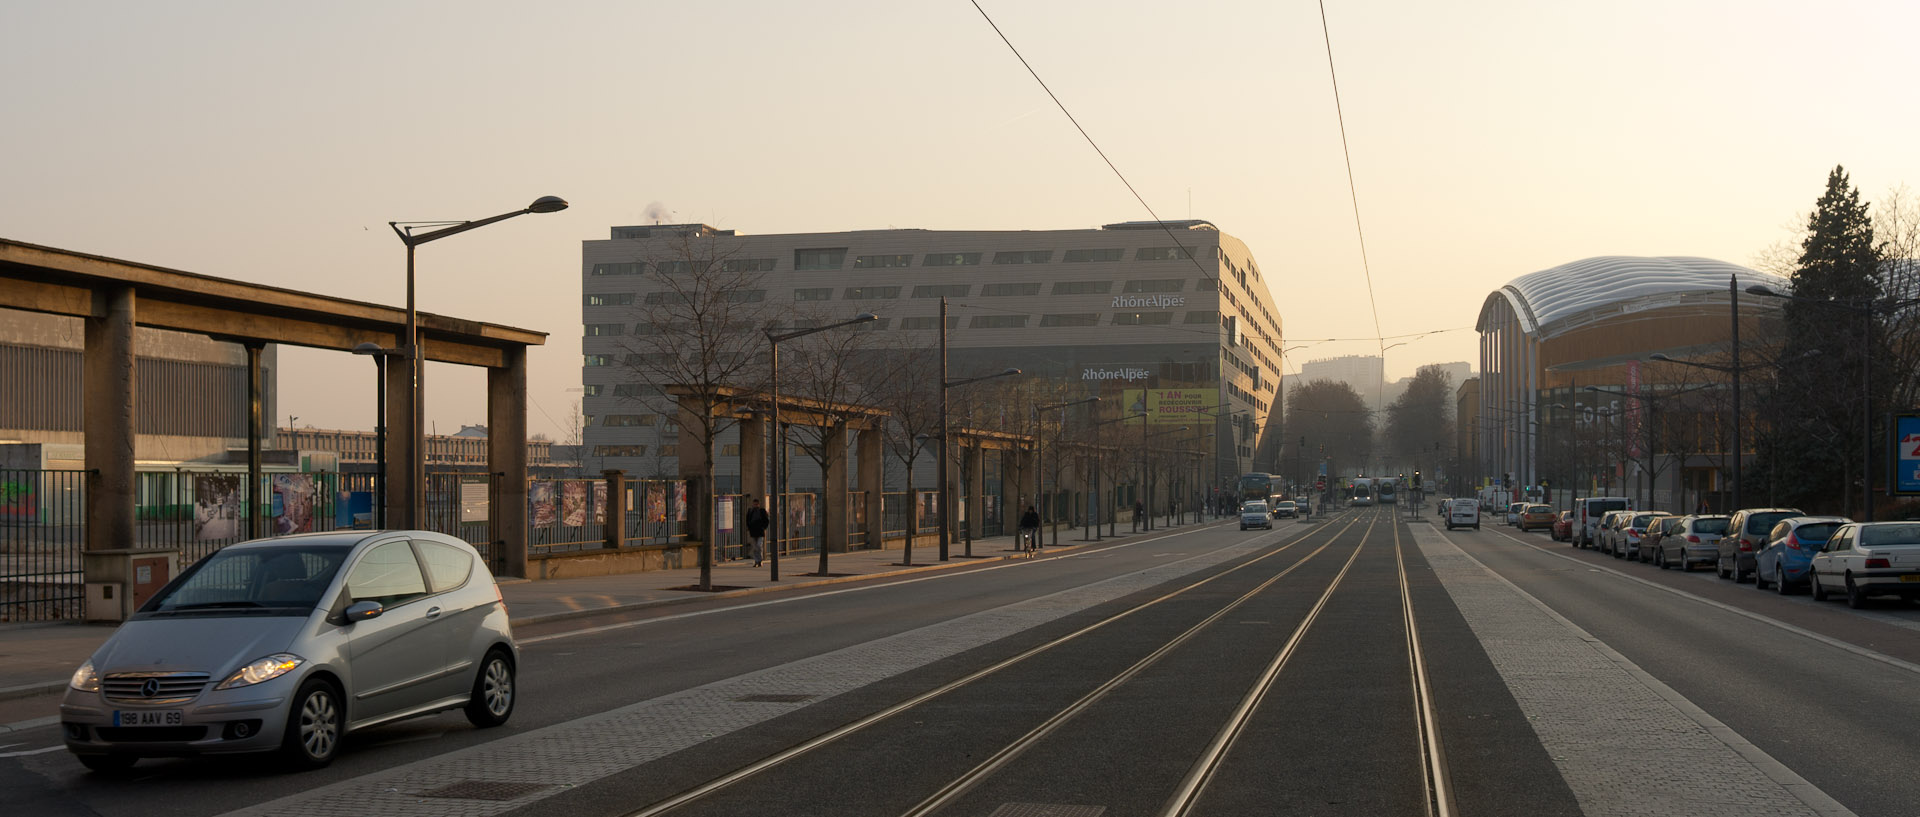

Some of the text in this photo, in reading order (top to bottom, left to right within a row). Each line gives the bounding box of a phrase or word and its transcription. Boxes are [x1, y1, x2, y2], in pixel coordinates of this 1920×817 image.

[1167, 391, 1182, 399] AN
[121, 712, 181, 725] 198 AAV 69
